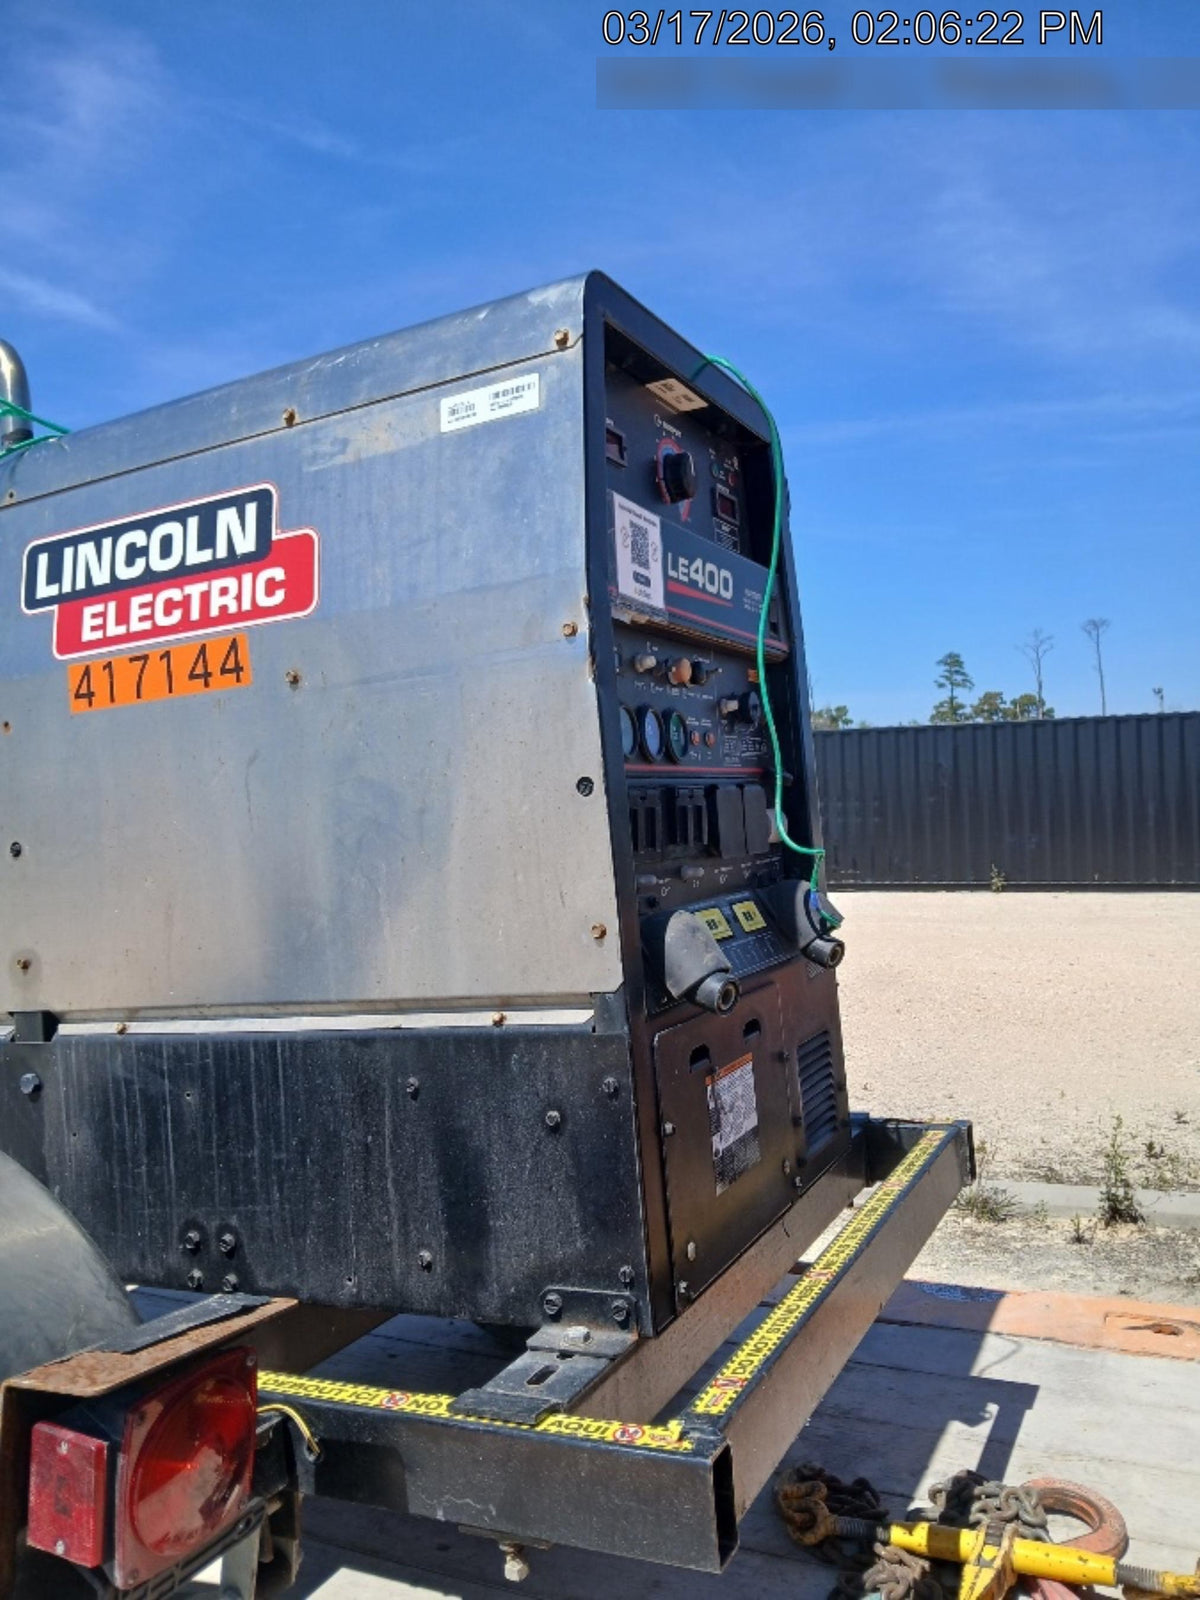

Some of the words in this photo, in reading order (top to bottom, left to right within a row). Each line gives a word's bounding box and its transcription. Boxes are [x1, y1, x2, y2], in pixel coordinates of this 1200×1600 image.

[35, 501, 258, 600] LINCOLN
[667, 551, 734, 601] LE400
[81, 566, 286, 643] ELECTRIC
[74, 637, 244, 708] 417144
[730, 1358, 754, 1375] DO
[746, 1335, 773, 1358] NOT
[765, 1303, 801, 1334] STAND
[407, 1398, 442, 1411] NO
